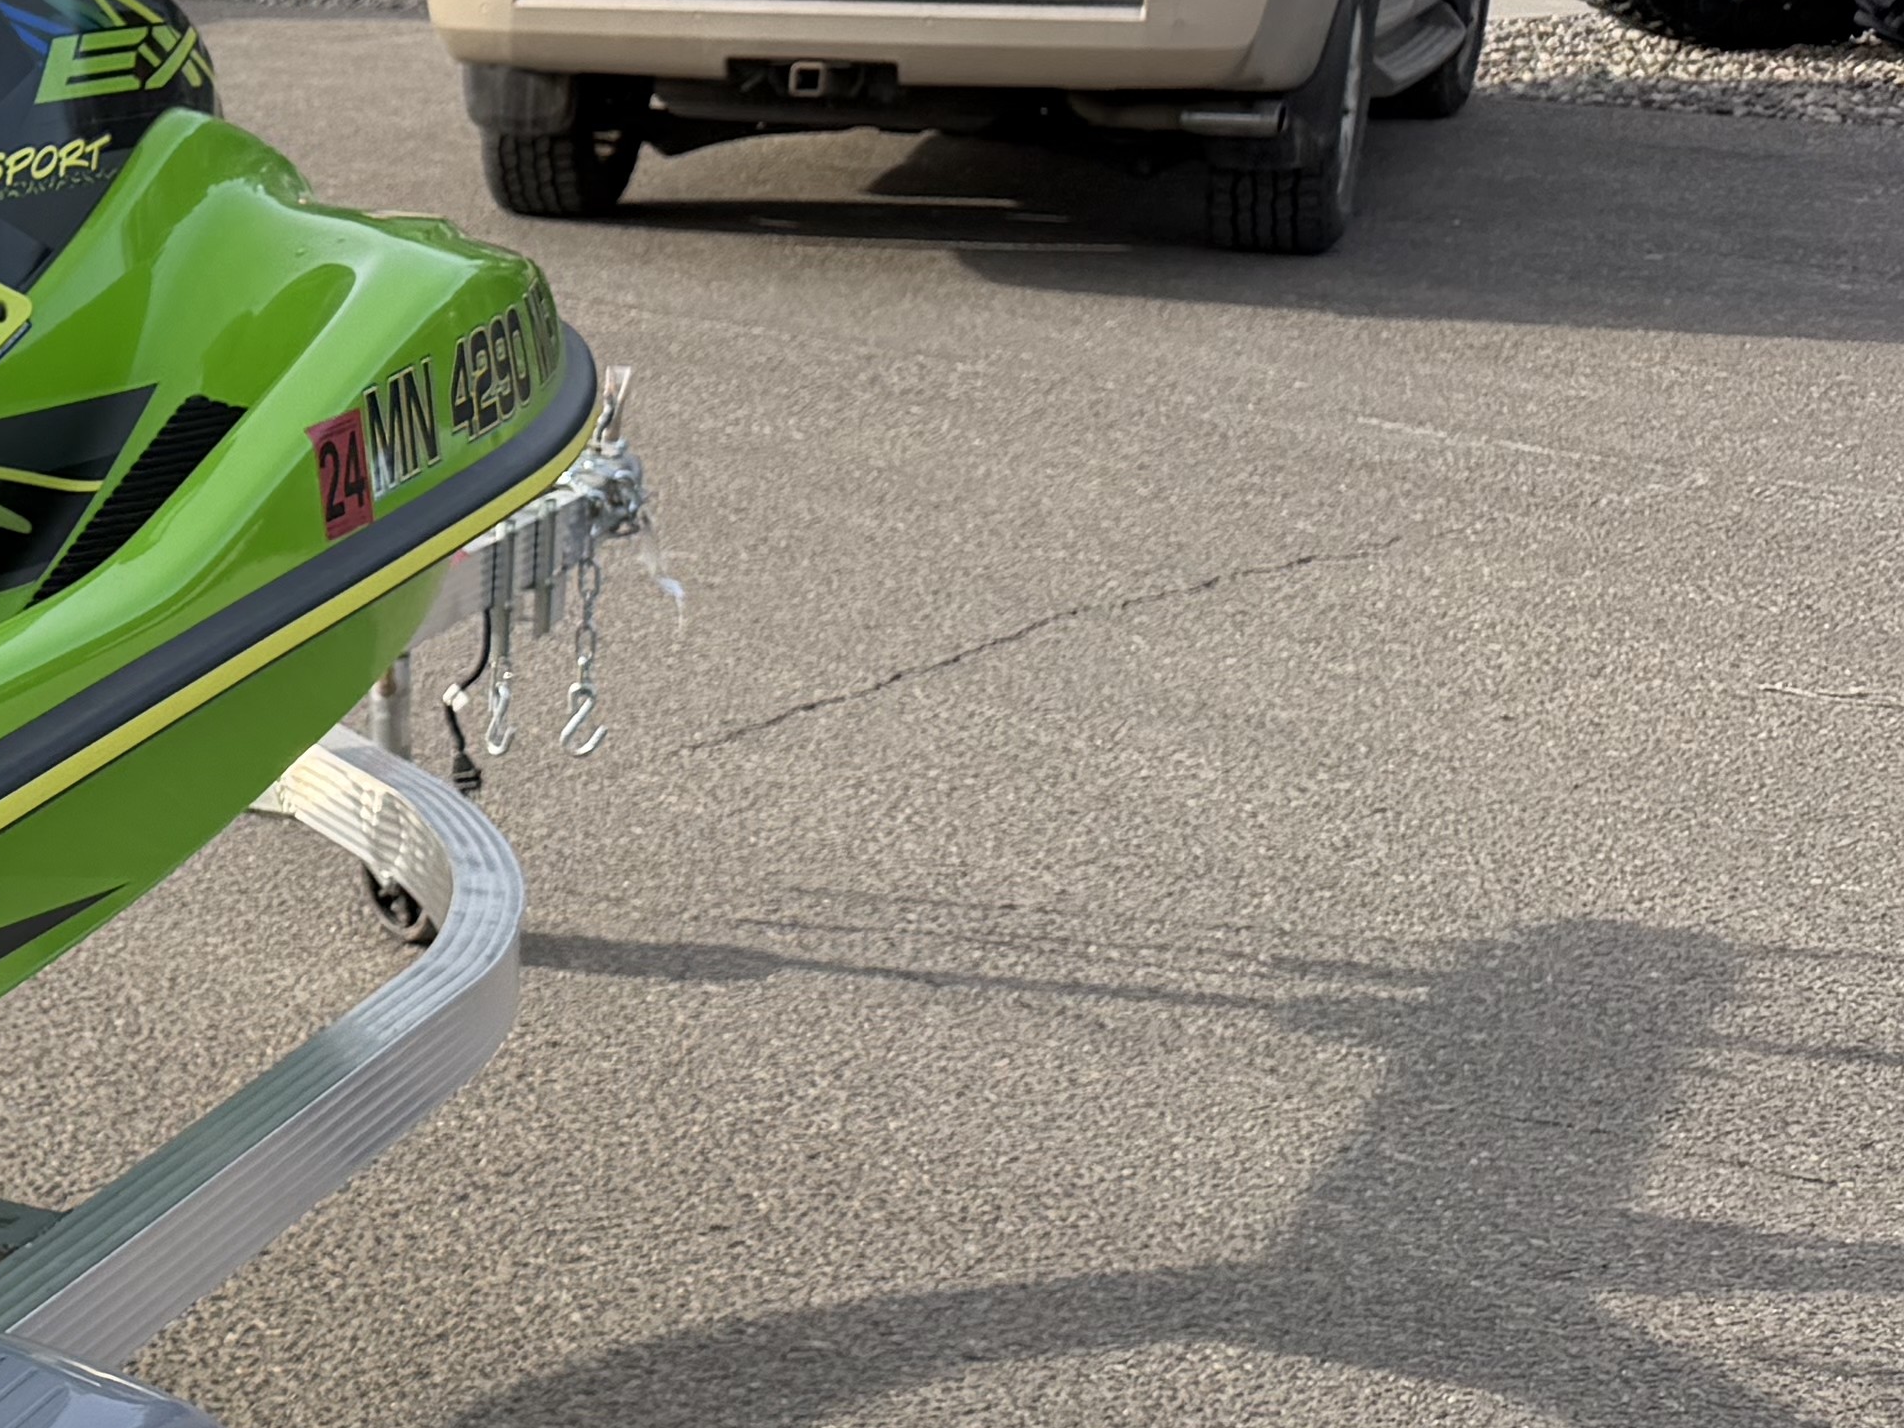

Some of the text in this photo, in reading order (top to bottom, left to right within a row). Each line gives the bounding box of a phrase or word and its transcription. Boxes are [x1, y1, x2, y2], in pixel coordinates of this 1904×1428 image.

[34, 22, 214, 104] EX
[363, 357, 441, 502] MN
[450, 304, 532, 443] 4290
[318, 430, 366, 522] 24
